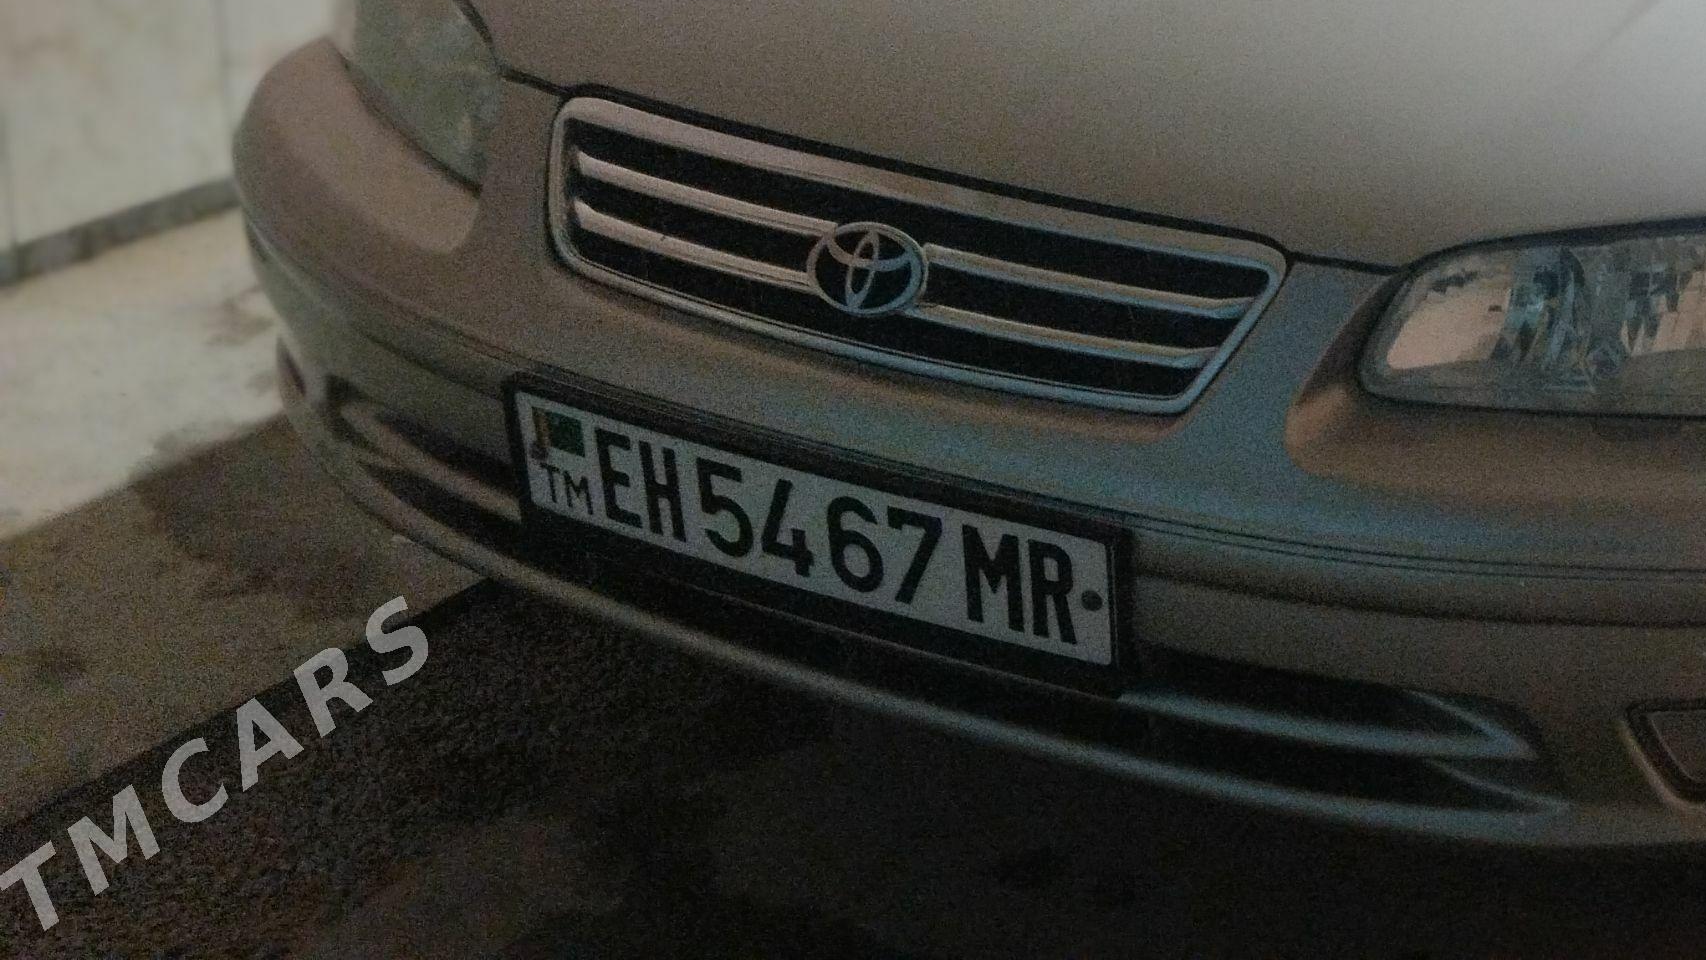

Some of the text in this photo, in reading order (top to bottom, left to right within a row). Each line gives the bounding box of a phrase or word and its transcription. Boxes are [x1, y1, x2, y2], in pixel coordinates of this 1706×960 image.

[540, 462, 594, 515] TM
[696, 457, 943, 605] 5467
[961, 523, 1079, 645] MR
